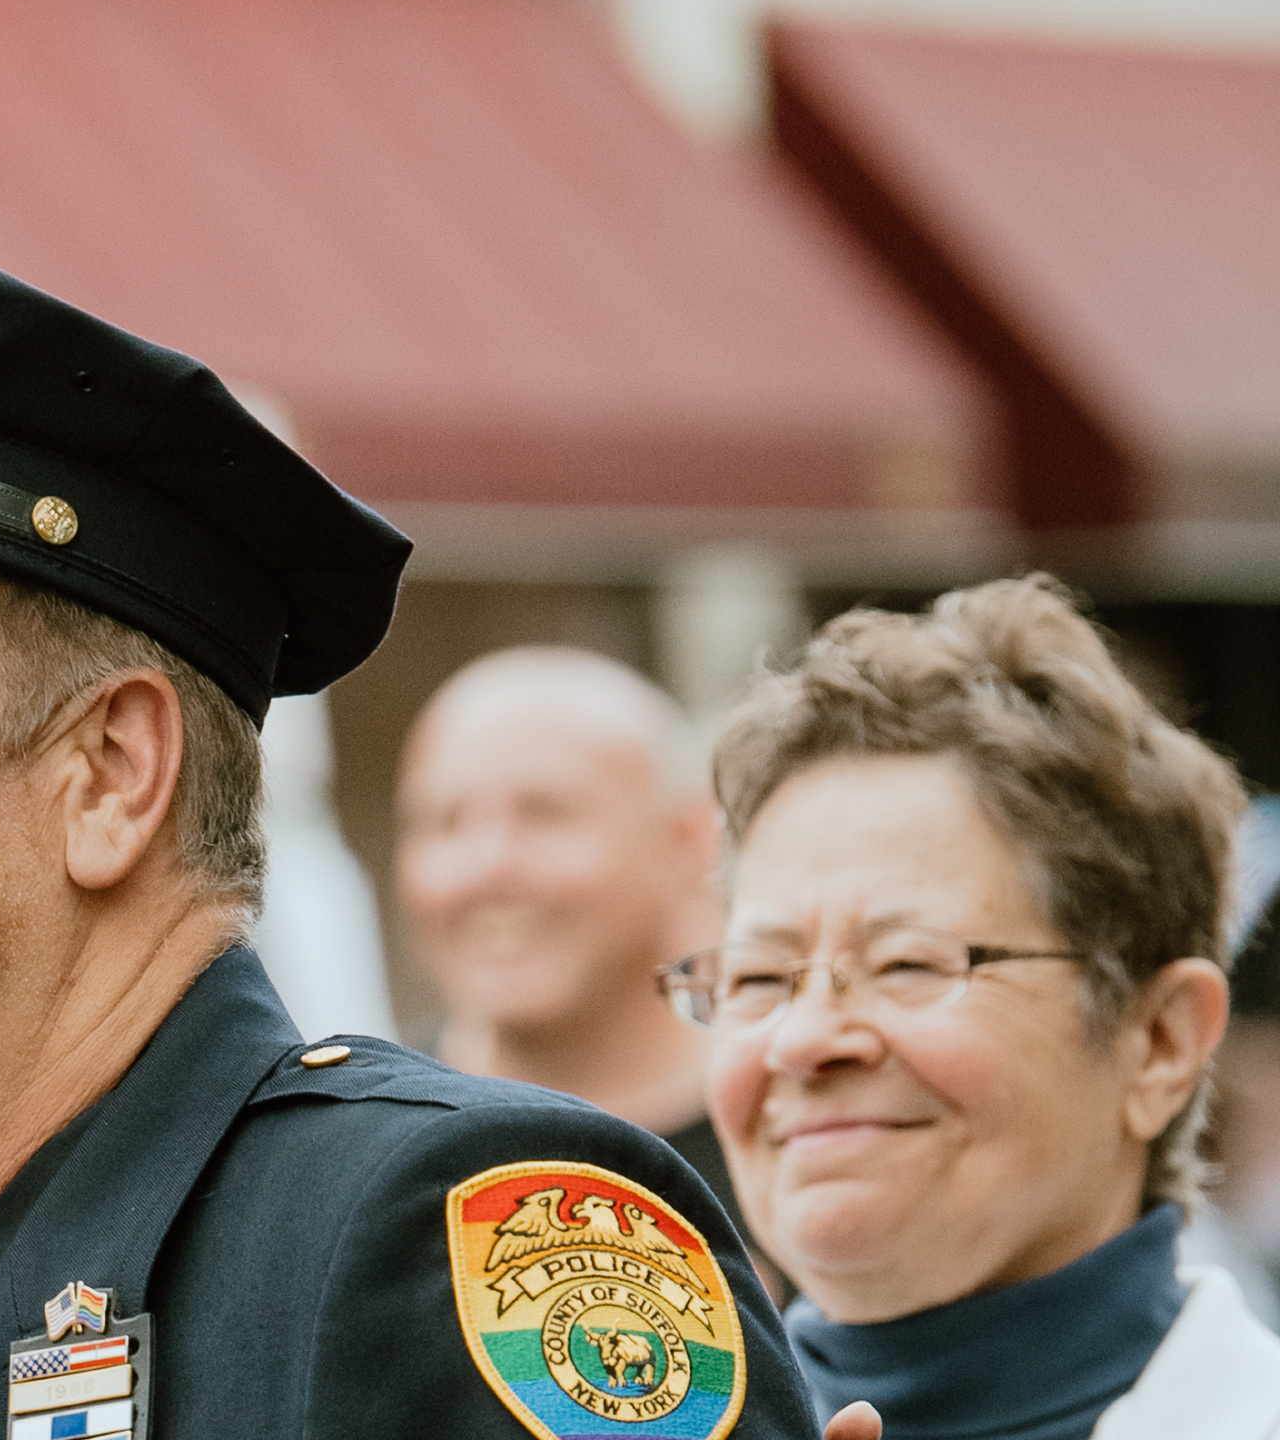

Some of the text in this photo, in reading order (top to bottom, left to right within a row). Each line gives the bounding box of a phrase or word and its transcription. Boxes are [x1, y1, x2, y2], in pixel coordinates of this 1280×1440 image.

[541, 1253, 665, 1292] POLICE
[546, 1285, 688, 1375] COUNTY OF SUFFOLK
[569, 1380, 681, 1418] NEW YORK
